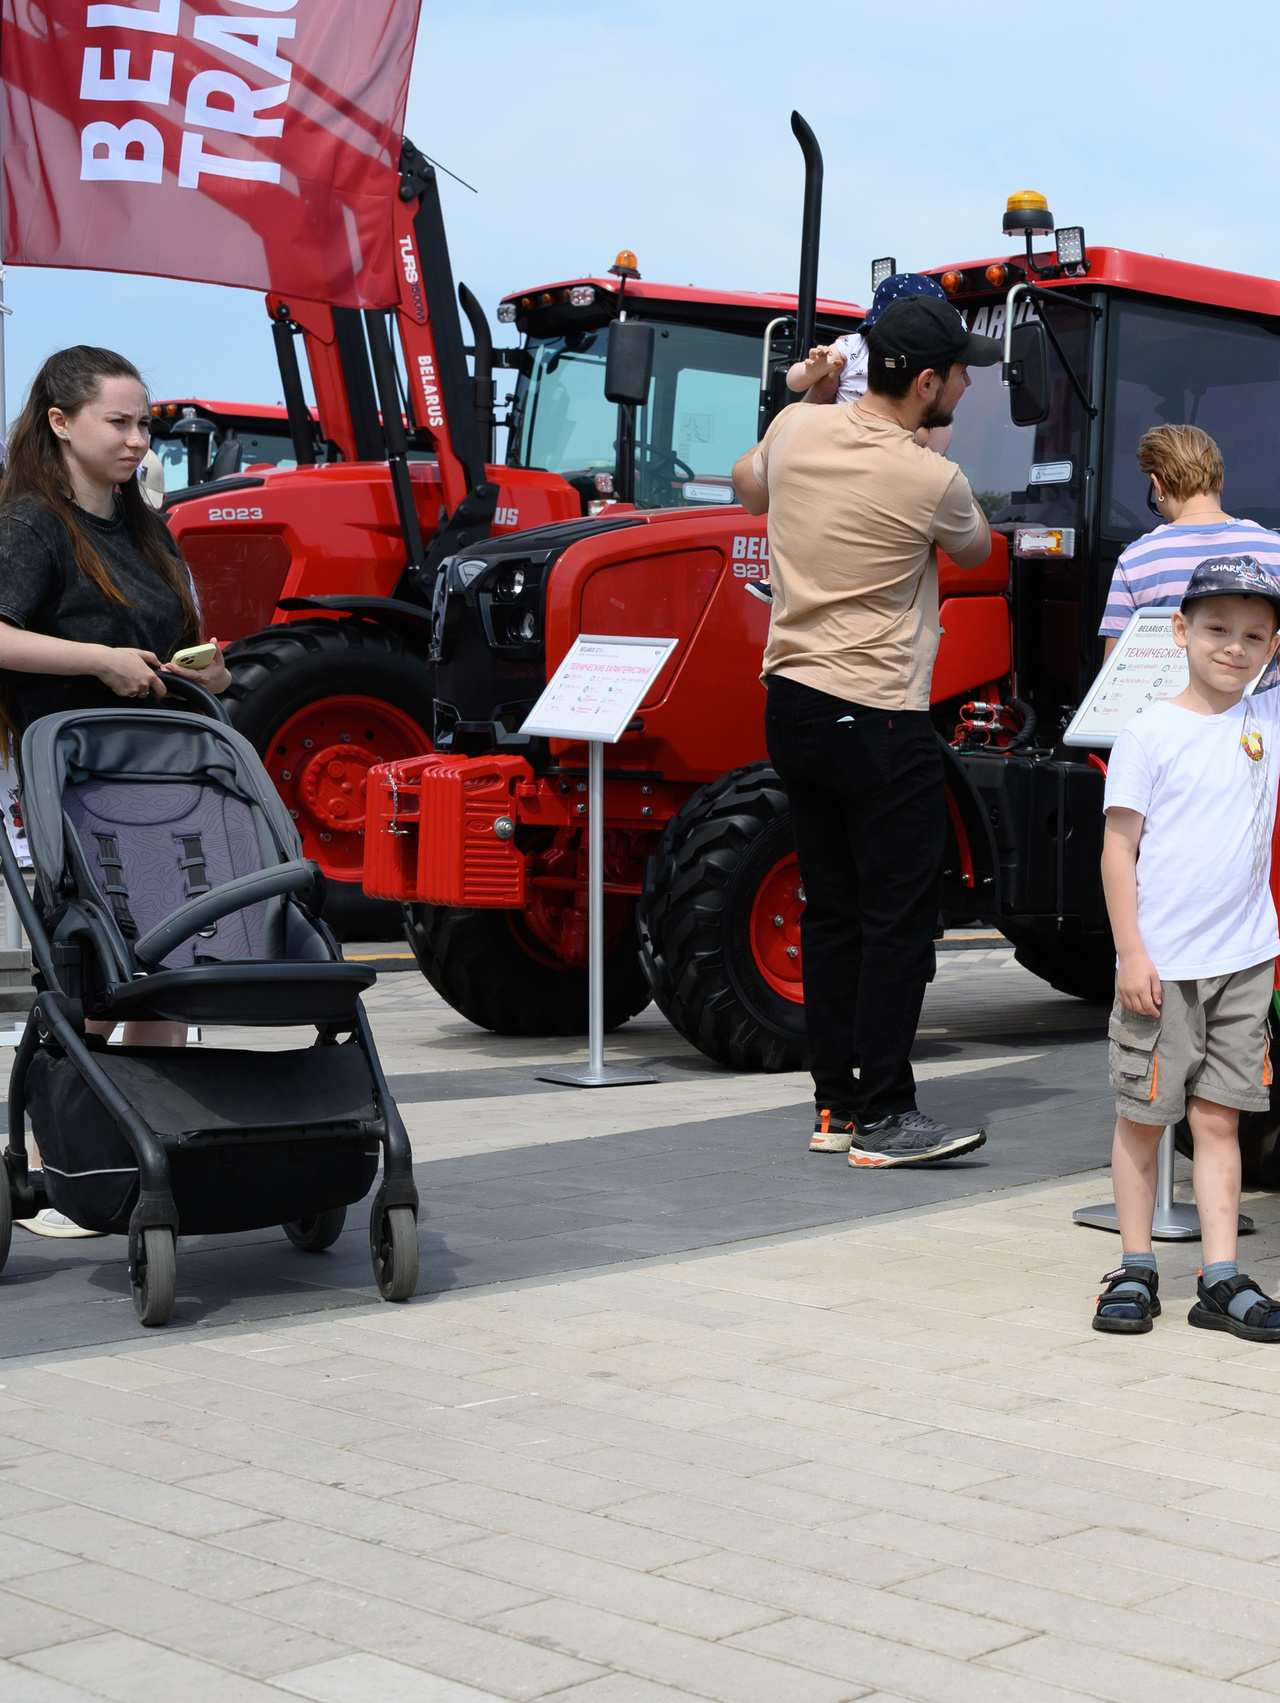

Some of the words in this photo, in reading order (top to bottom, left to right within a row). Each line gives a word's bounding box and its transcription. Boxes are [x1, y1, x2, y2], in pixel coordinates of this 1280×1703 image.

[79, 0, 181, 184] BEL
[178, 0, 299, 189] TRA
[399, 235, 419, 284] TURS
[411, 283, 426, 320] 1500M
[418, 355, 444, 426] BELARUS
[208, 507, 263, 521] 2023
[732, 536, 769, 560] BEL
[1138, 625, 1163, 633] BELARUS
[1125, 647, 1185, 659] ТЕХНИЧЕСКИЕ
